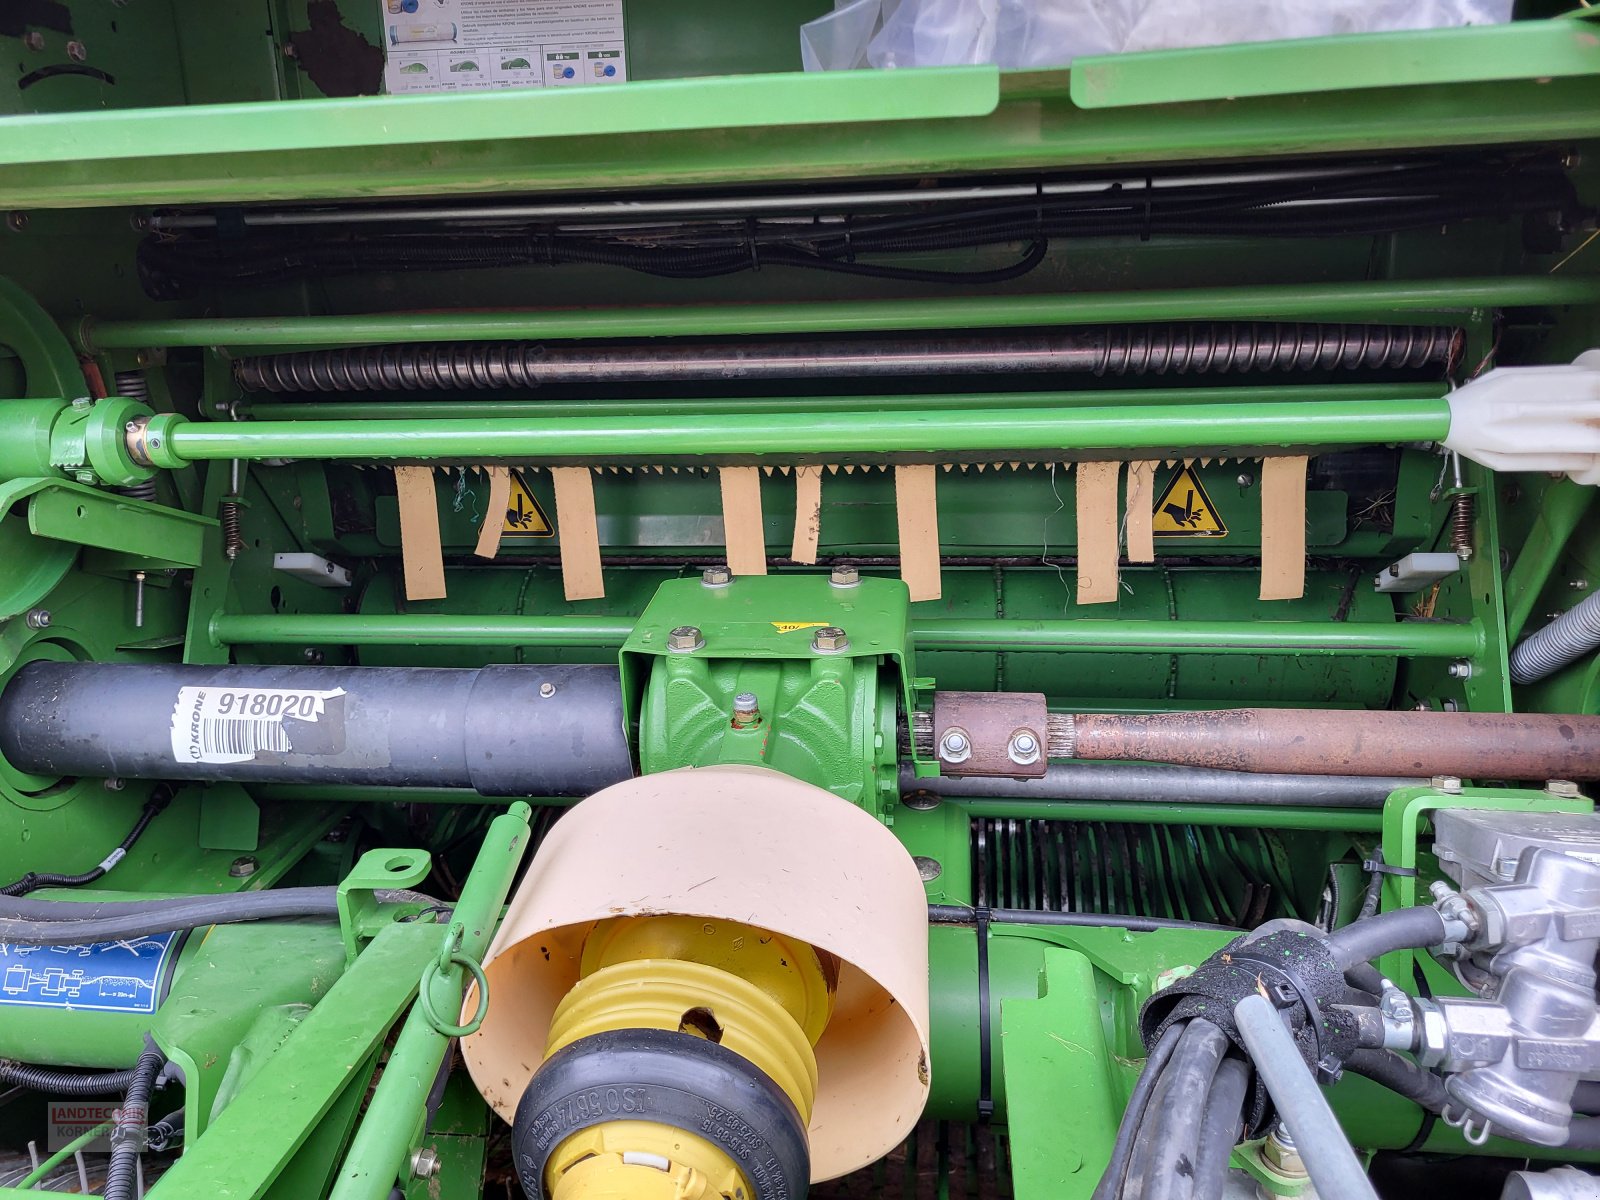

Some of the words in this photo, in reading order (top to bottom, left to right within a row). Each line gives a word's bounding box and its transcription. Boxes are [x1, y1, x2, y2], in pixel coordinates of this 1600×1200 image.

[217, 692, 316, 717] 918020
[190, 690, 207, 745] KRONE
[606, 1088, 647, 1113] ISO
